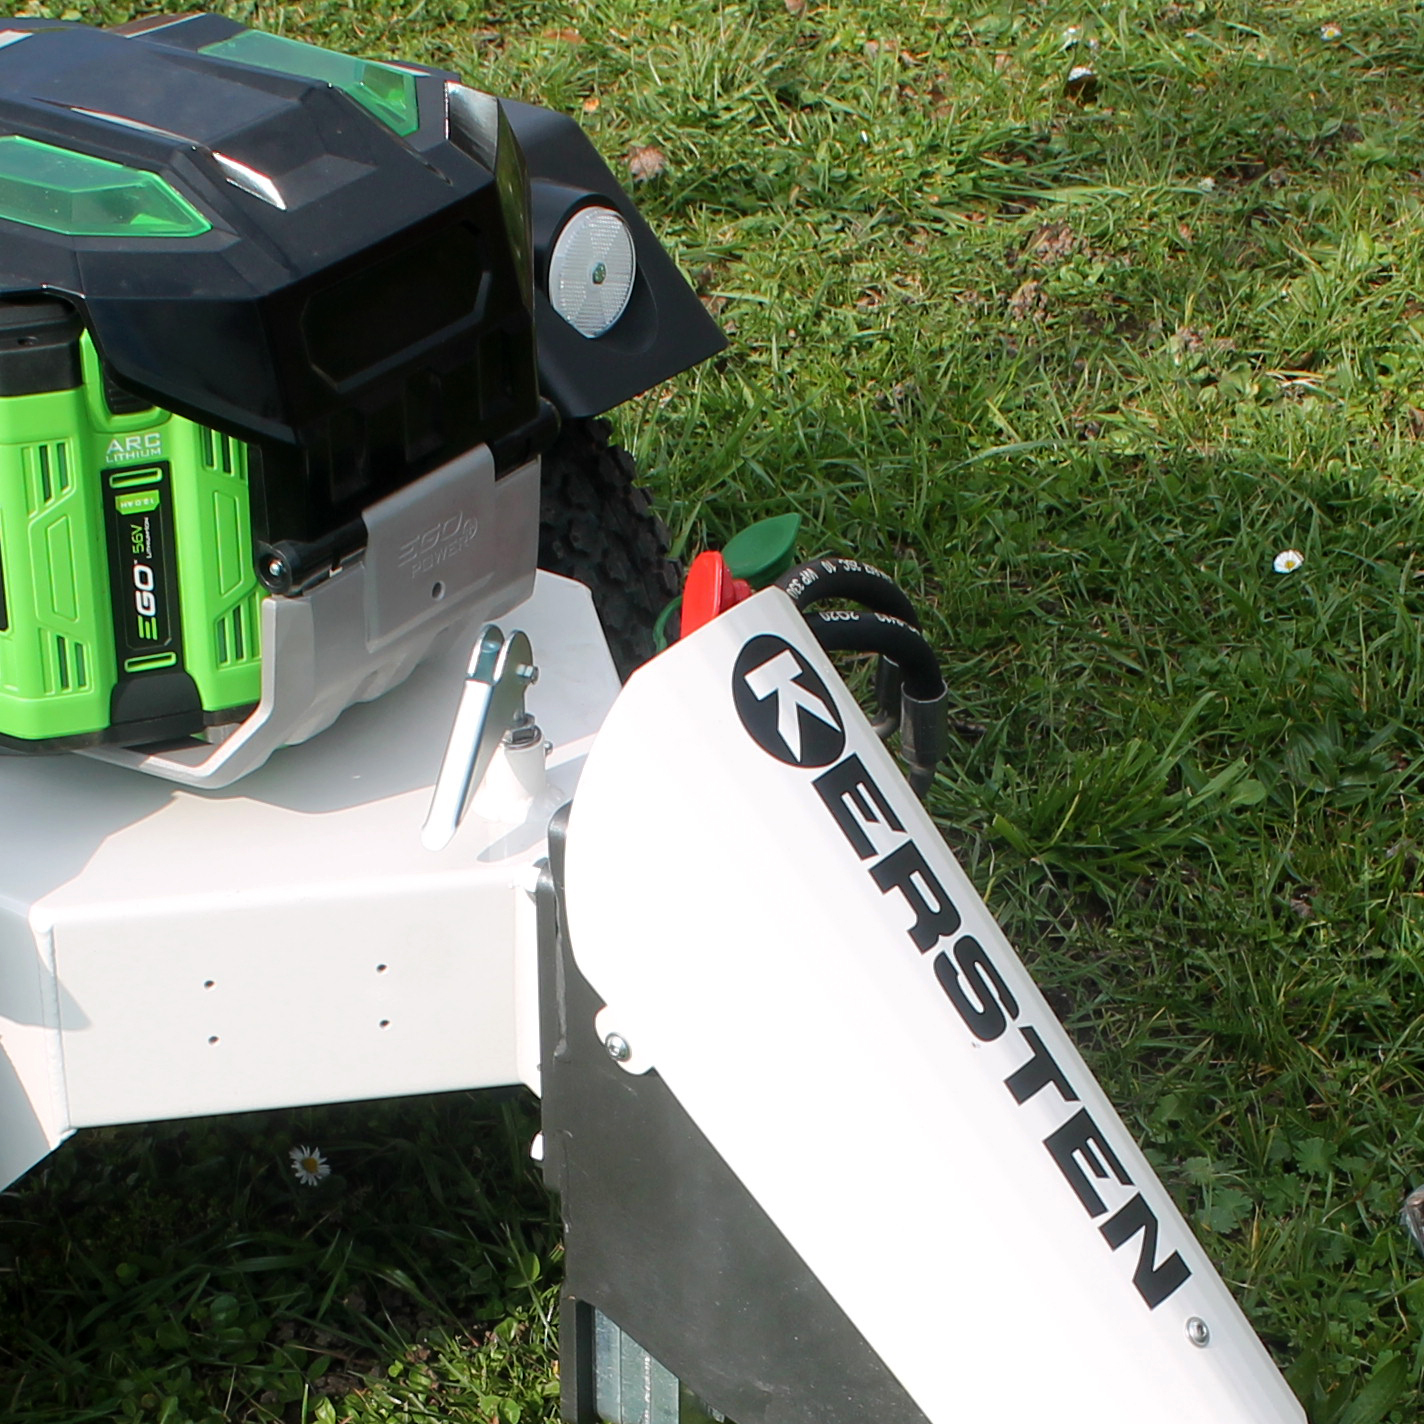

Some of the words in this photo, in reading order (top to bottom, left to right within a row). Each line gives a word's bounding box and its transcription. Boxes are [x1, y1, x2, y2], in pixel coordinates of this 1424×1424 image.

[105, 447, 162, 464] LITHIUM
[106, 432, 161, 455] ARC
[131, 523, 145, 555] 56V
[398, 511, 463, 568] EGO
[133, 563, 158, 640] EGO
[736, 640, 1192, 1310] KERSTEN
